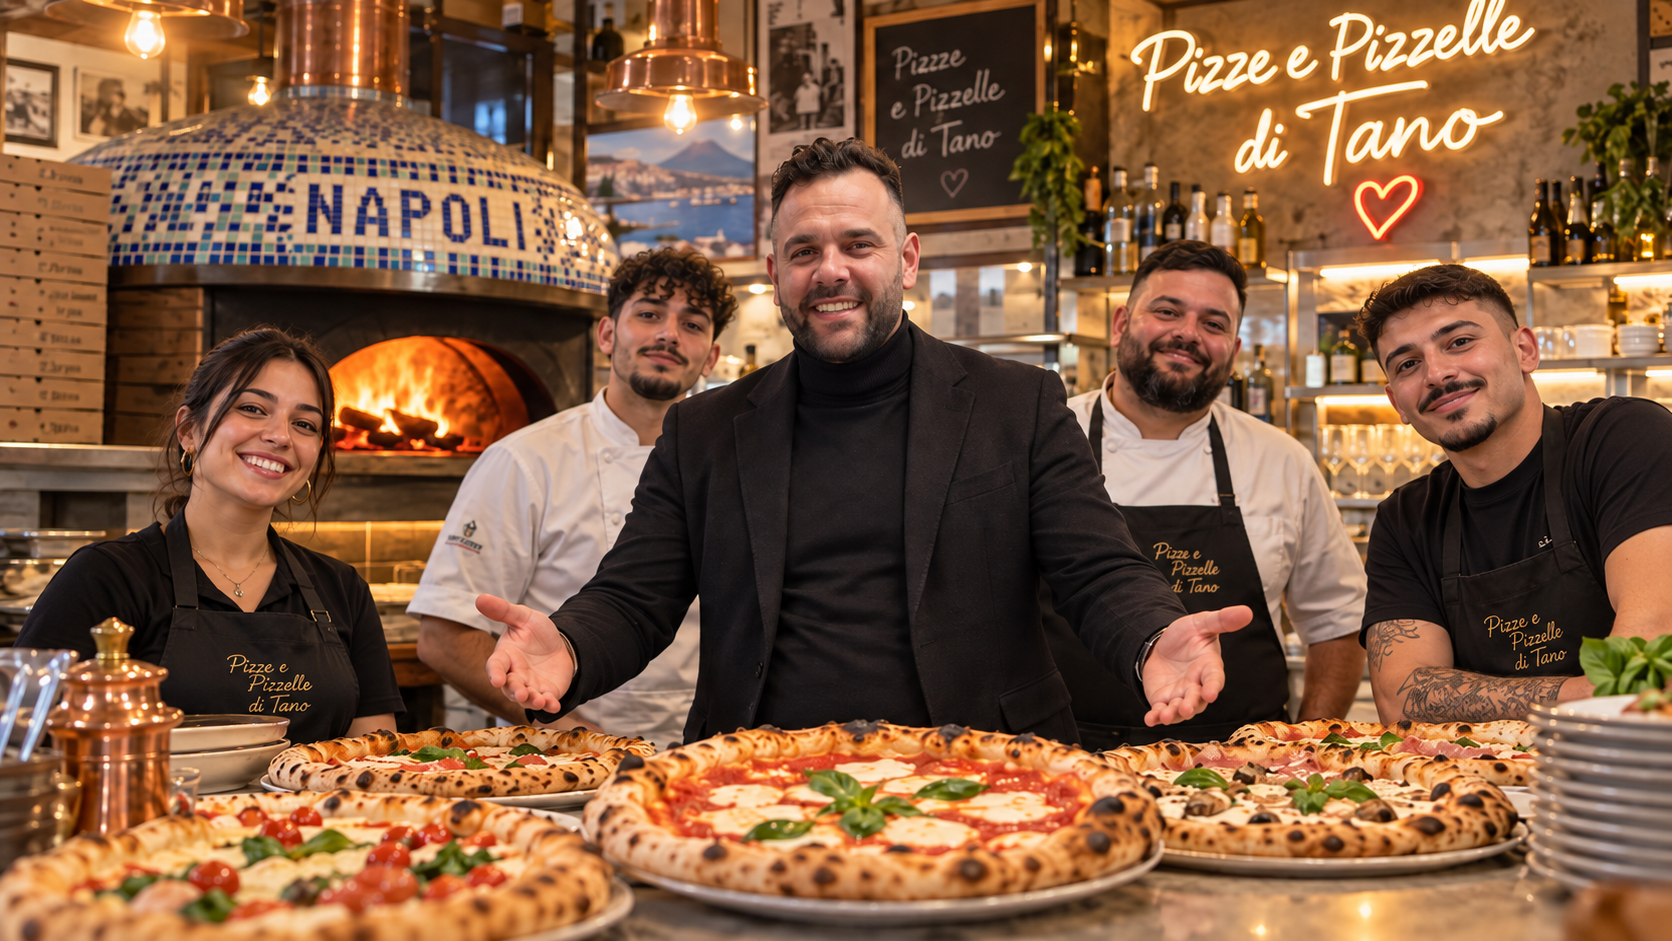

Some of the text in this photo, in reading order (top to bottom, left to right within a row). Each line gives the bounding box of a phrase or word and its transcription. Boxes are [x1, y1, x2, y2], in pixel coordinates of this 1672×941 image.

[1130, 0, 1536, 112] Pizze e Pizzelle
[890, 68, 1006, 119] e Pizzelle
[901, 119, 1002, 159] di Tano
[1234, 80, 1504, 186] di Tano
[306, 183, 525, 250] NAPOLI
[1153, 542, 1201, 560] Pizze e
[1171, 560, 1220, 576] Pizzelle
[1171, 577, 1220, 594] di Tano
[1483, 613, 1541, 638] Pizze e
[1509, 620, 1564, 651] Pizzelle
[226, 654, 289, 674] Pizze e
[1514, 646, 1568, 671] di Tano
[247, 673, 313, 692] Pizzelle
[248, 694, 311, 714] di Tano
